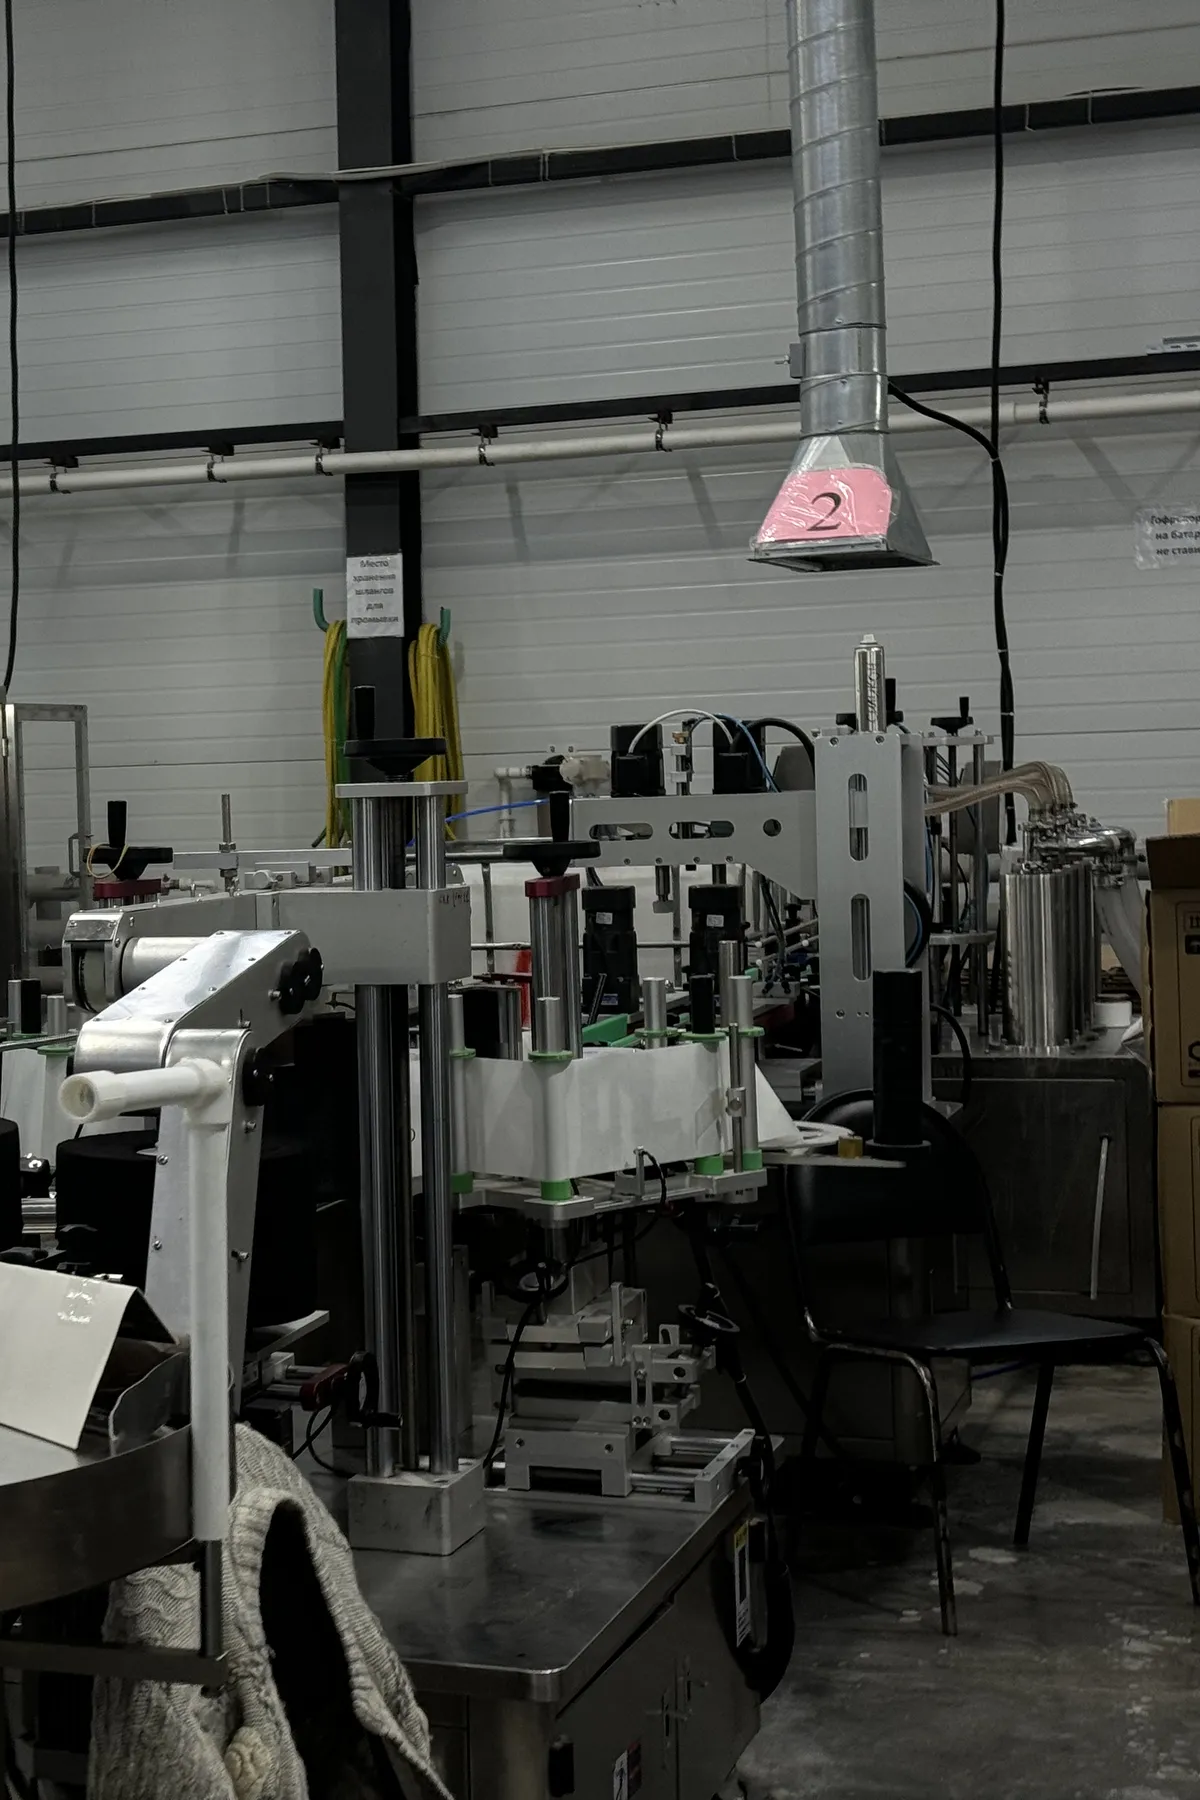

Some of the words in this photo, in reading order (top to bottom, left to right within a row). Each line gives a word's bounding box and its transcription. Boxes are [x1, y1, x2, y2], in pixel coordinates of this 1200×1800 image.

[806, 492, 842, 532] 2
[1155, 532, 1168, 540] на
[1156, 548, 1170, 556] не
